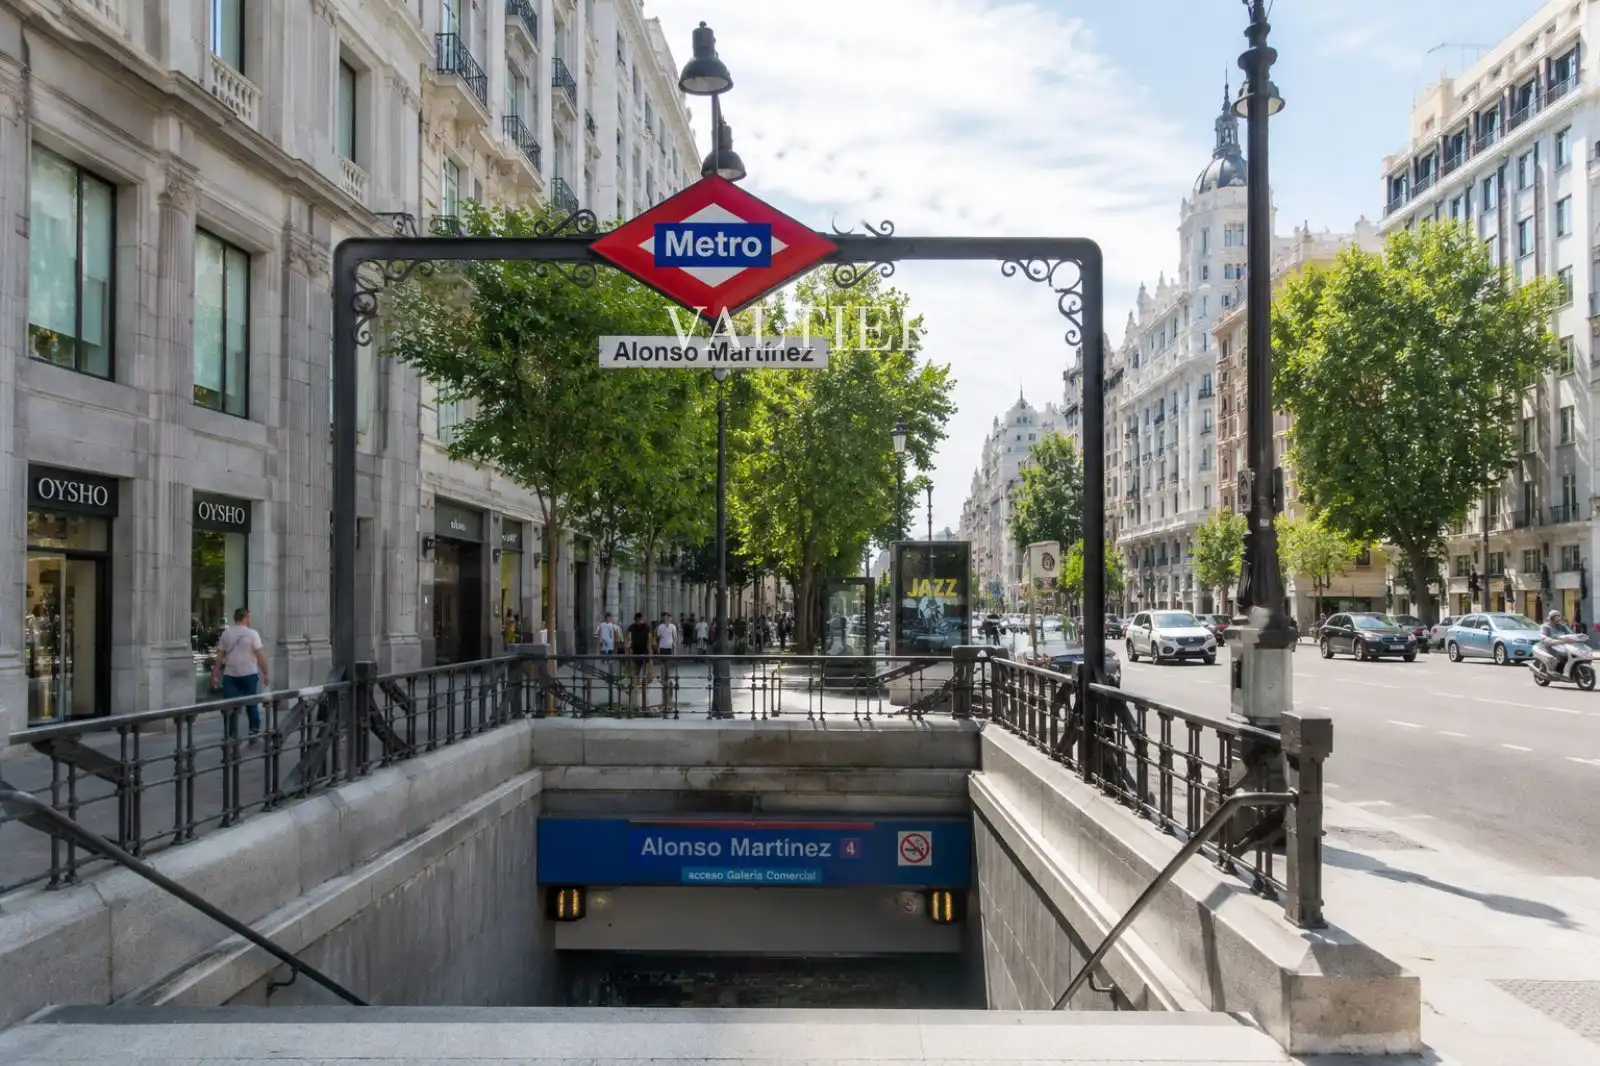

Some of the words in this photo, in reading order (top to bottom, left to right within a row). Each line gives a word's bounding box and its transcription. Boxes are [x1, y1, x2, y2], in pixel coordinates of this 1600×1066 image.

[665, 230, 763, 258] Metro
[613, 342, 699, 362] Alonso
[707, 342, 814, 362] Martínez
[38, 477, 108, 506] OYSHO
[198, 501, 245, 524] OYSHO
[907, 577, 958, 597] JAZZ
[640, 837, 722, 856] Alonso
[730, 837, 832, 858] Martínez
[845, 841, 856, 856] 4
[688, 871, 724, 880] acceso
[766, 870, 816, 881] Comercial
